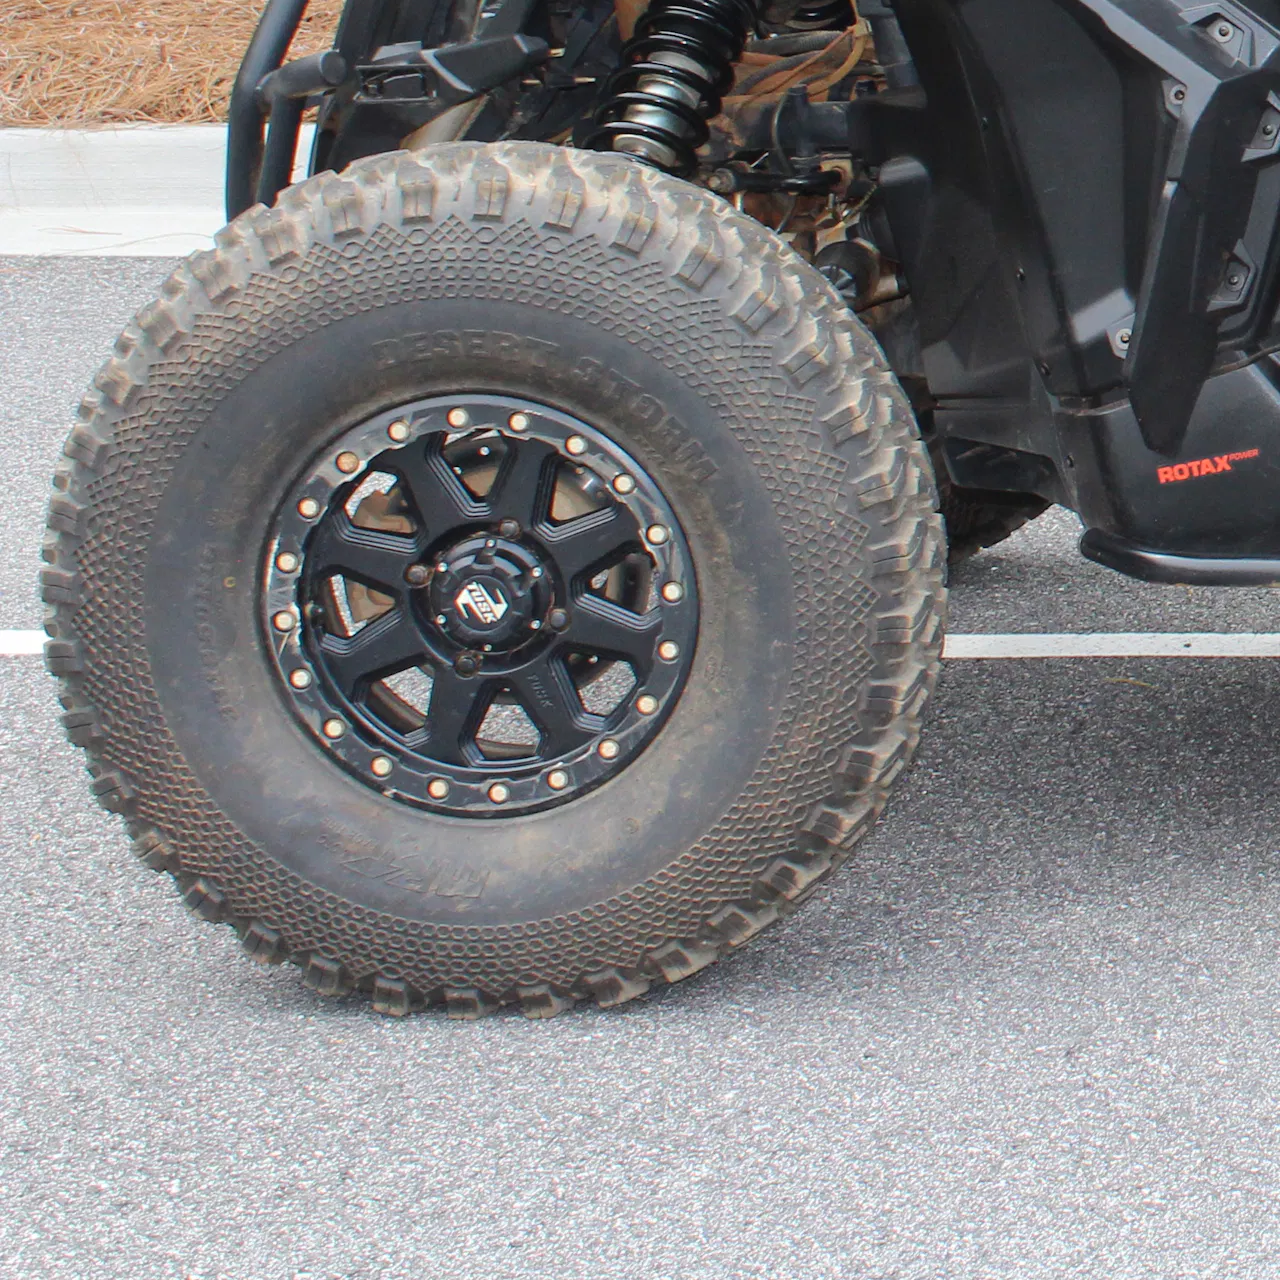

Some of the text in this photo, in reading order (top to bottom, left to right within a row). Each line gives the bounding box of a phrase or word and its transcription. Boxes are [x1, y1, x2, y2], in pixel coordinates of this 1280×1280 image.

[1156, 447, 1261, 484] ROTAX POWER
[466, 581, 498, 624] TUSK
